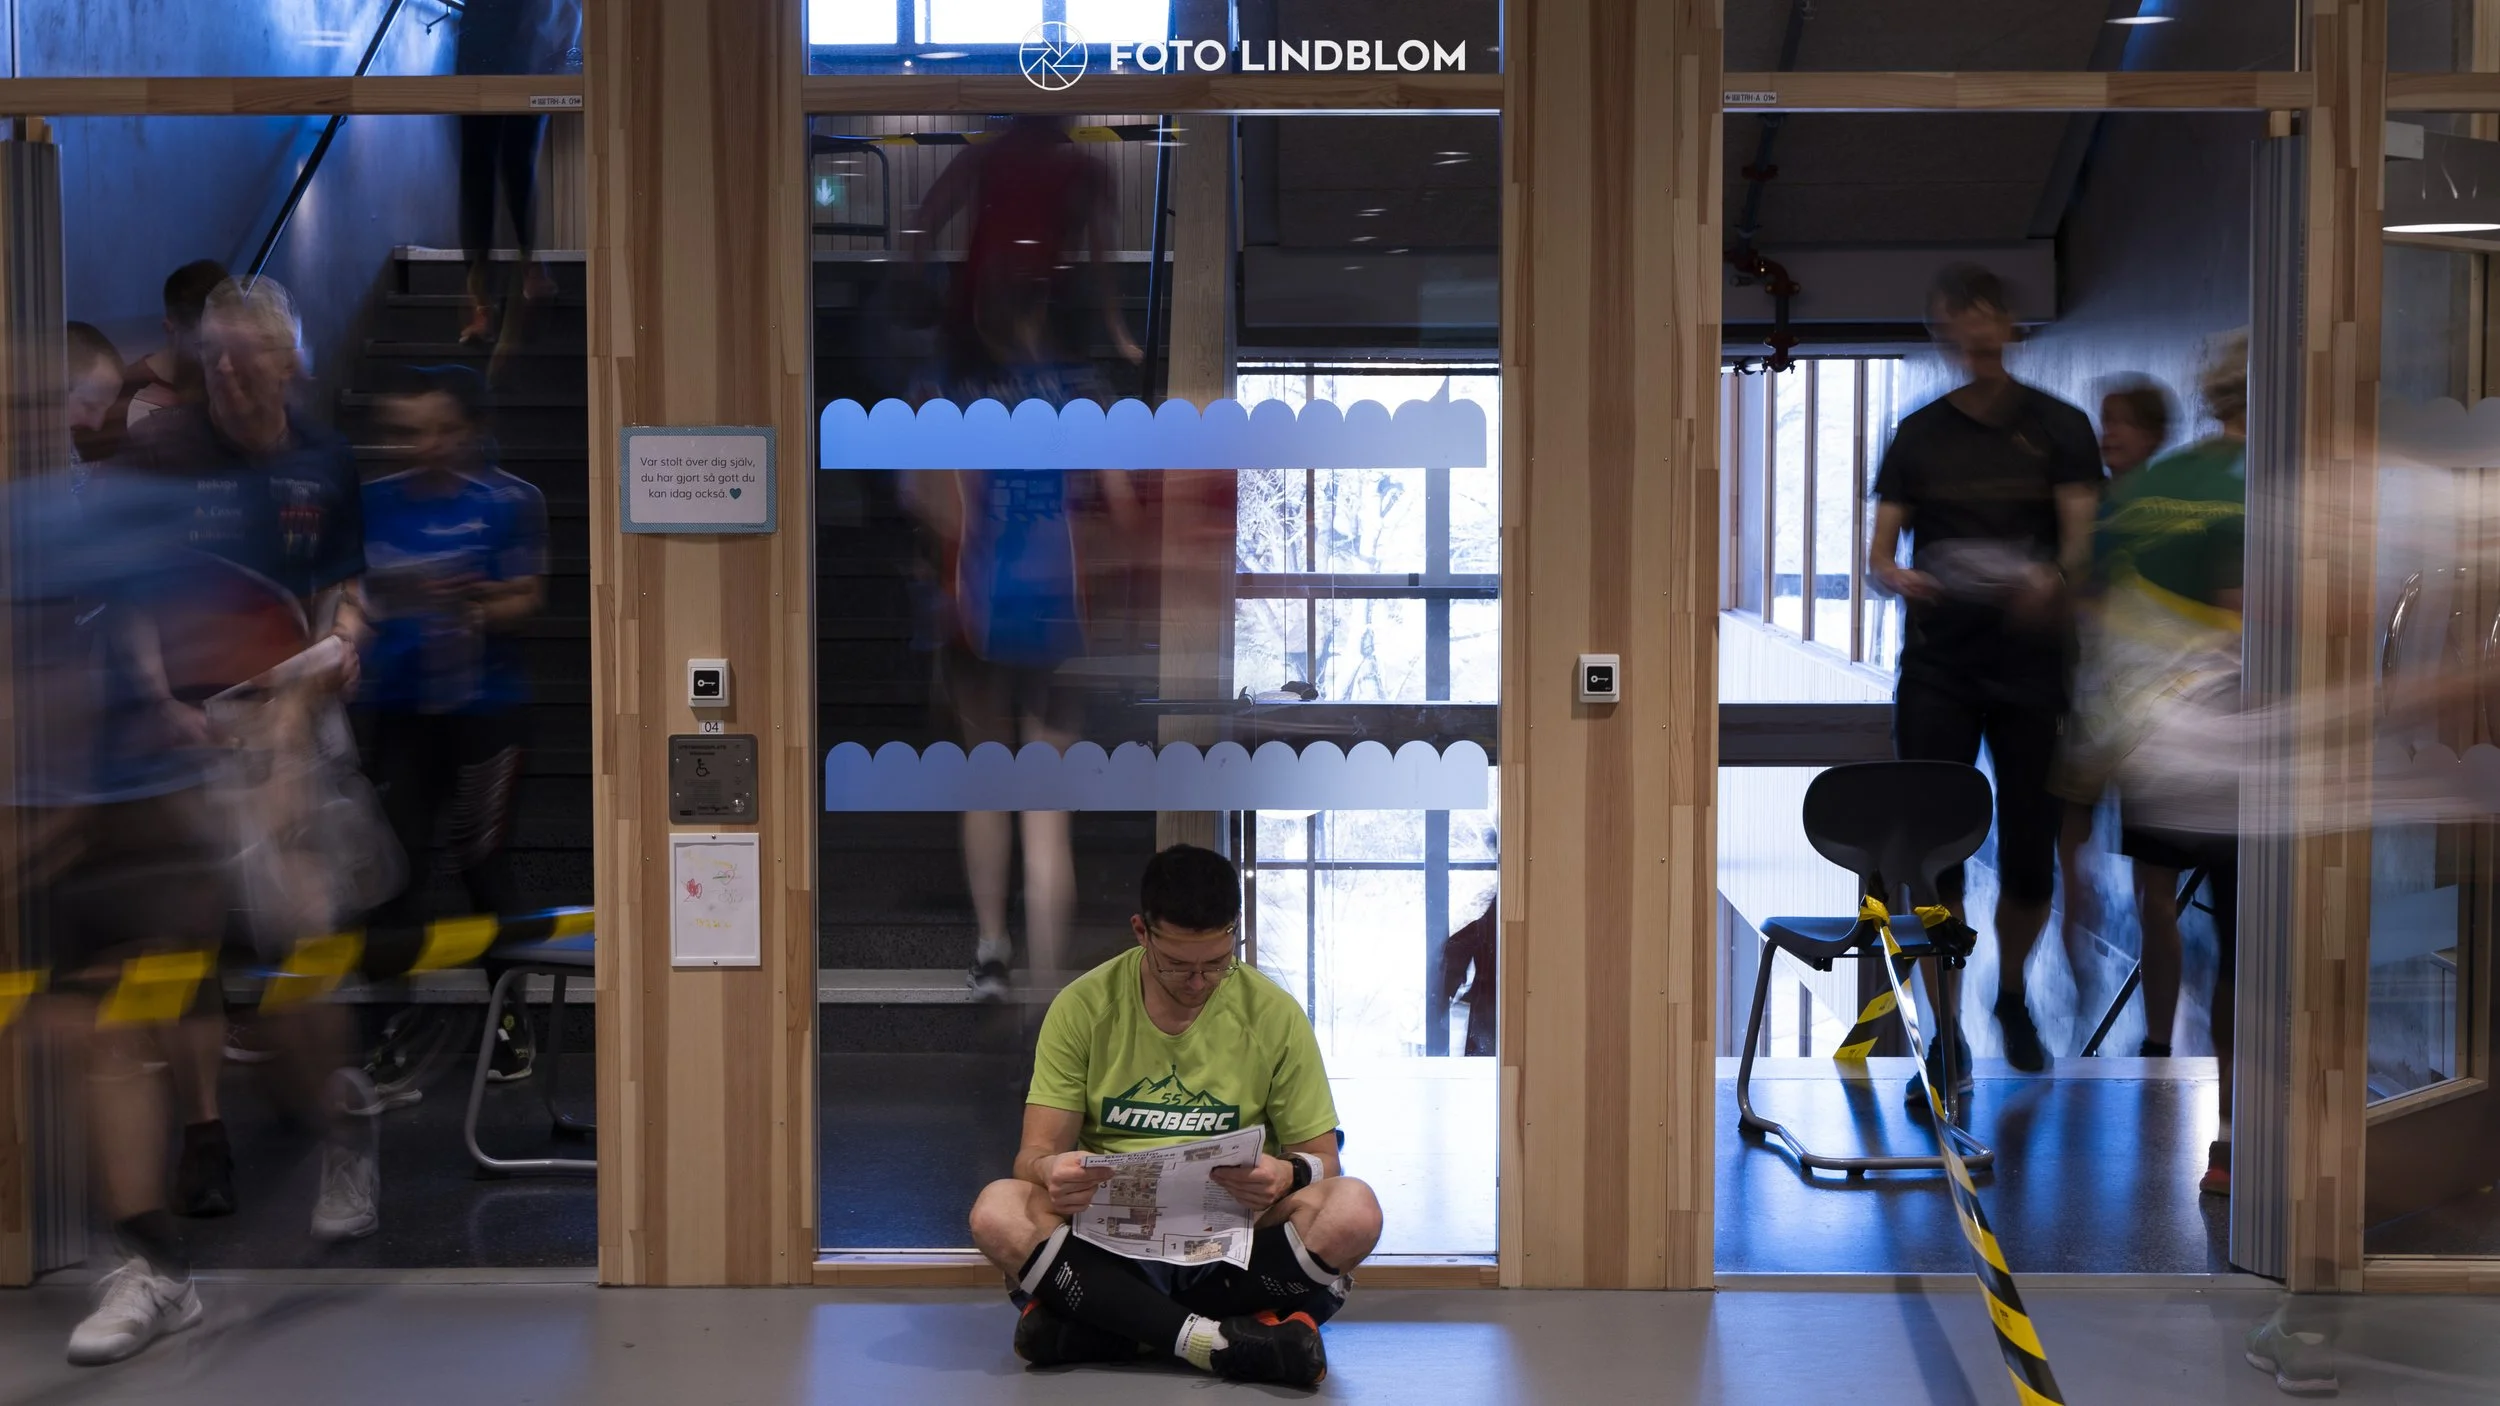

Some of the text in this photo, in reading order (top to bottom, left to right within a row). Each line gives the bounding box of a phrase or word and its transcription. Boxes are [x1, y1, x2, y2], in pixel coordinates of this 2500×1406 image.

[640, 457, 756, 468] Var stolt över dig själv,
[641, 473, 755, 484] du har gjort så gott du
[648, 489, 728, 500] kan idag också.
[704, 721, 719, 733] 04
[1161, 1093, 1183, 1105] 55
[1106, 1105, 1235, 1131] MTRBÉRC
[1097, 1217, 1105, 1225] 2
